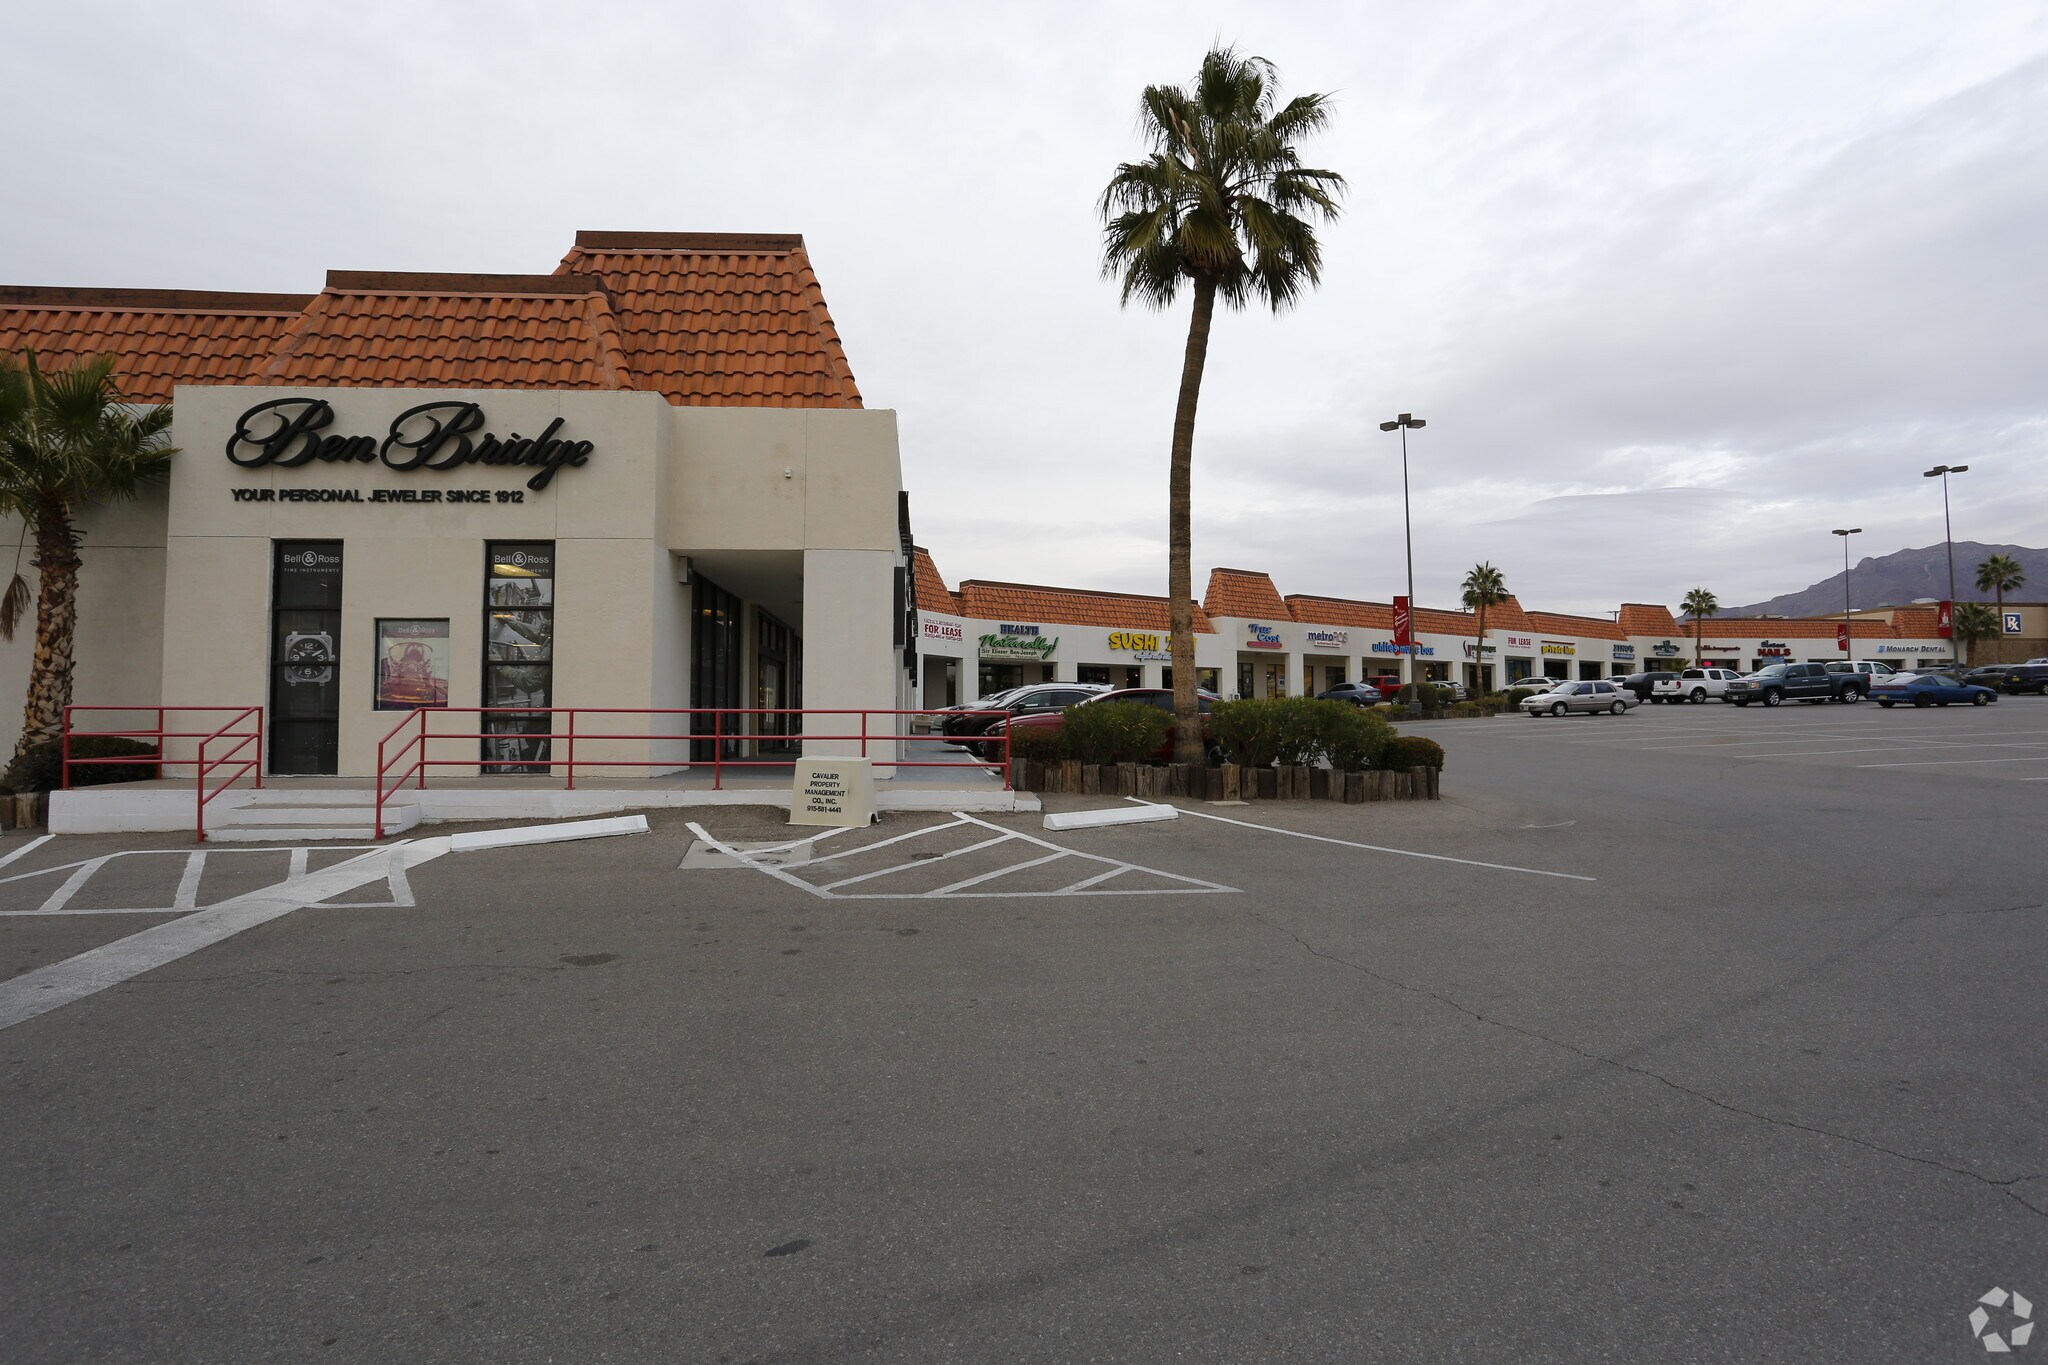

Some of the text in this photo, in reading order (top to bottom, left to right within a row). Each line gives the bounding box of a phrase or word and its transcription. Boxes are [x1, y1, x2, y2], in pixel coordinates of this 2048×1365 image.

[226, 397, 594, 491] Ben Bridge
[231, 488, 524, 503] YOUR PERSONAL JEWELER SINCE 1912
[284, 554, 301, 563] Bell
[318, 554, 340, 563] Ross
[494, 554, 511, 563] Bell
[527, 555, 549, 564] Ross
[924, 623, 939, 634] FOR
[941, 626, 962, 637] LEASE
[1000, 624, 1040, 636] HEALTH
[1108, 631, 1160, 651] SUSHI
[1307, 629, 1349, 644] metroPCS
[1507, 636, 1532, 646] FOR LEASE
[1399, 644, 1420, 655] muc
[1420, 644, 1434, 655] box
[1757, 648, 1791, 657] NAILS
